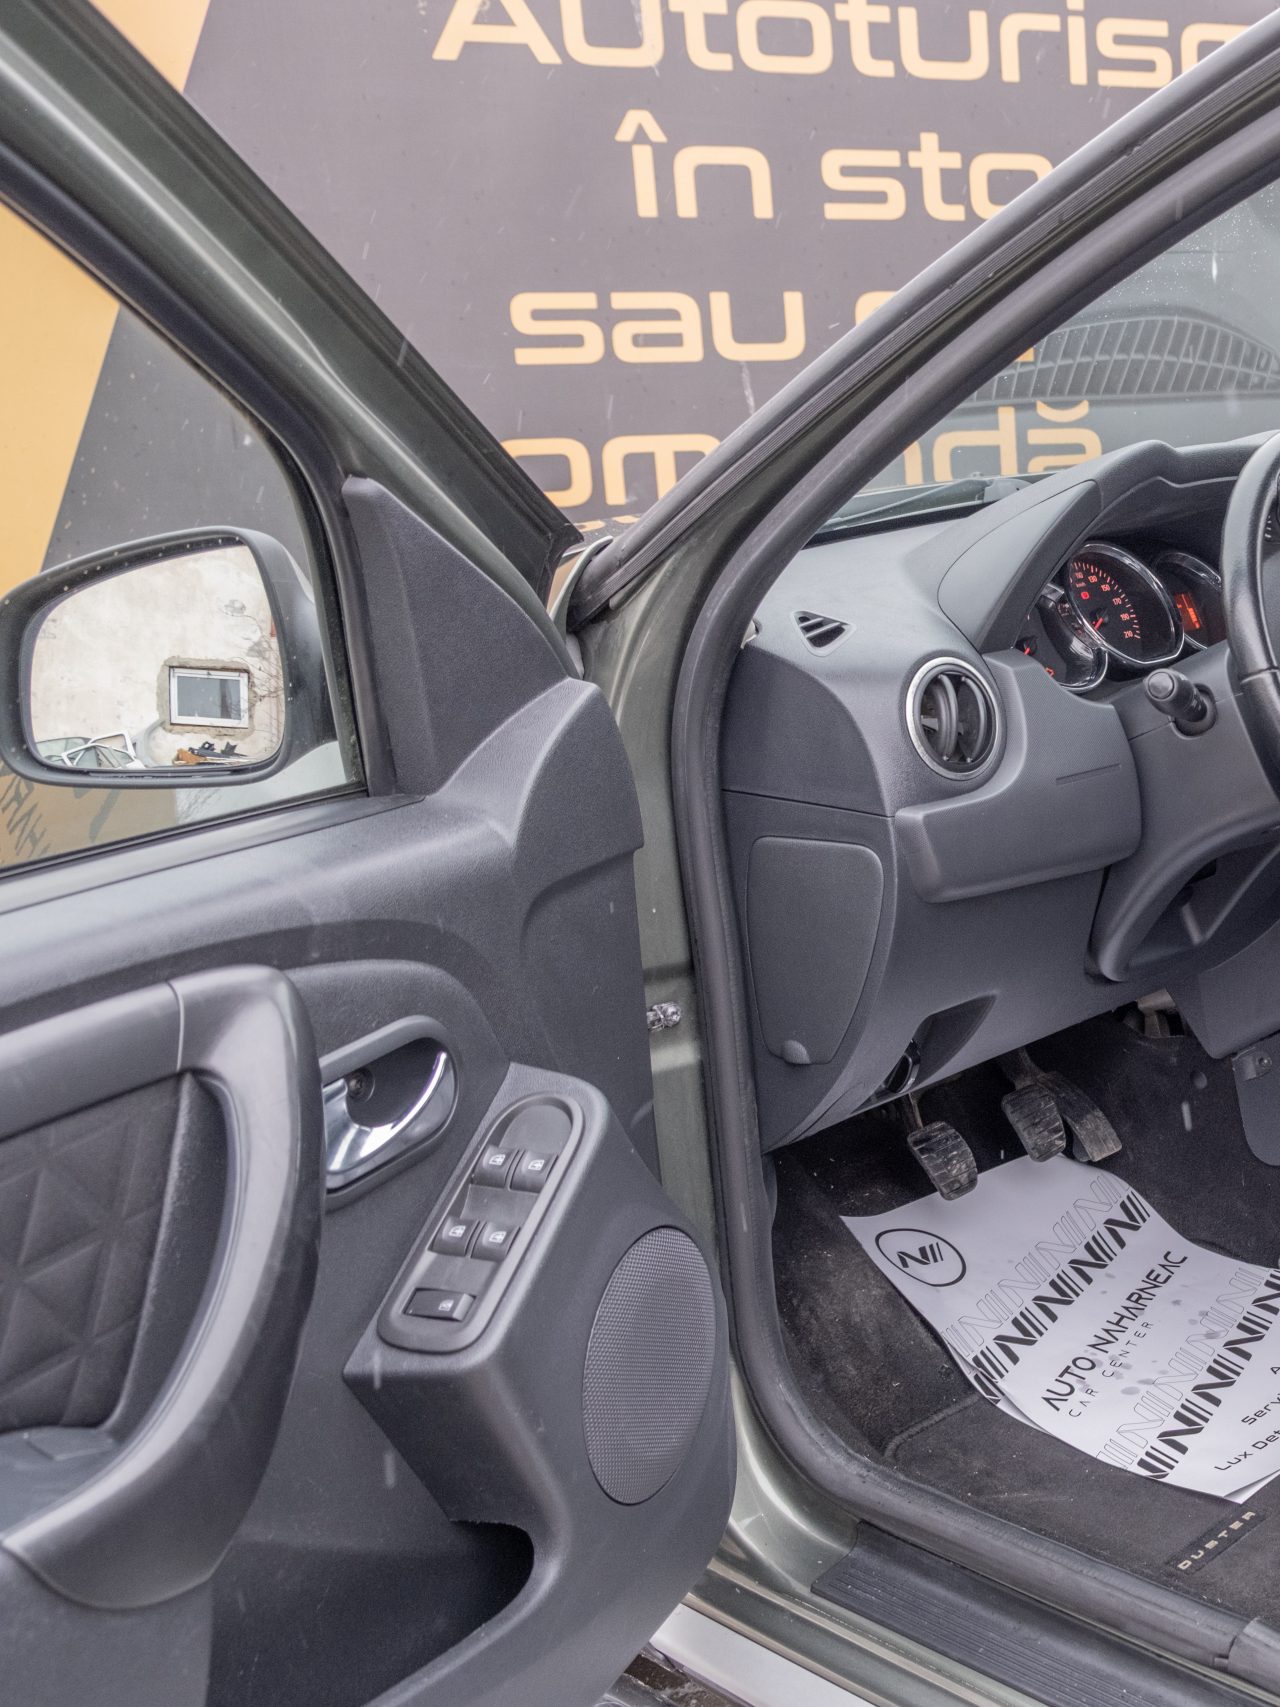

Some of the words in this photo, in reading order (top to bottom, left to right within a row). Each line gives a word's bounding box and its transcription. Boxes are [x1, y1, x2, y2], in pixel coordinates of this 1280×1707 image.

[821, 132, 1054, 221] sto
[510, 291, 806, 365] sau
[1113, 597, 1121, 605] 170
[1041, 1356, 1097, 1412] AUTO
[1086, 1250, 1188, 1354] NAHARNEAC
[1068, 1387, 1099, 1418] CAR
[1101, 1321, 1155, 1378] CENTER
[1214, 1450, 1253, 1471] Lux
[1177, 1511, 1256, 1570] DUSTER
